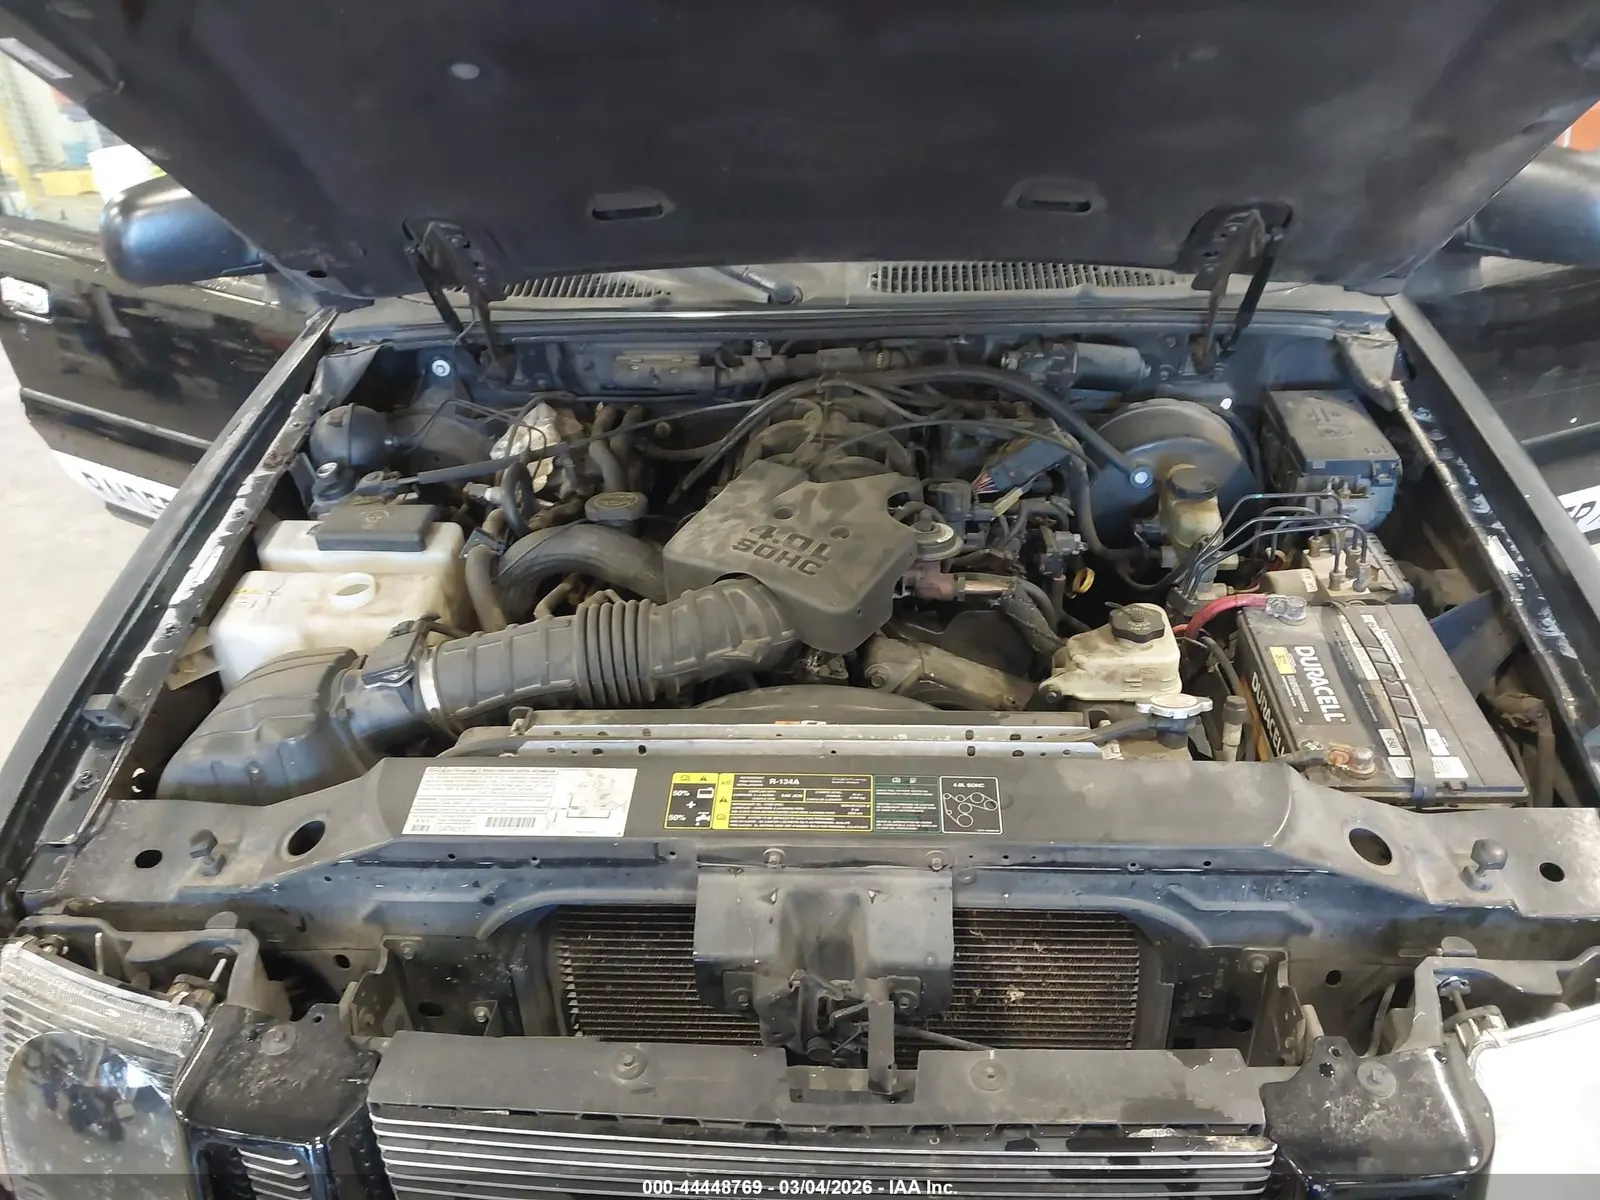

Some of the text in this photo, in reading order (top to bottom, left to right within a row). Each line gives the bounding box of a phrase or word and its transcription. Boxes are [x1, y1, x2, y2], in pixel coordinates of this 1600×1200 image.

[732, 537, 824, 576] SOHC
[1294, 645, 1346, 723] DURACELL
[769, 778, 800, 786] R-134A
